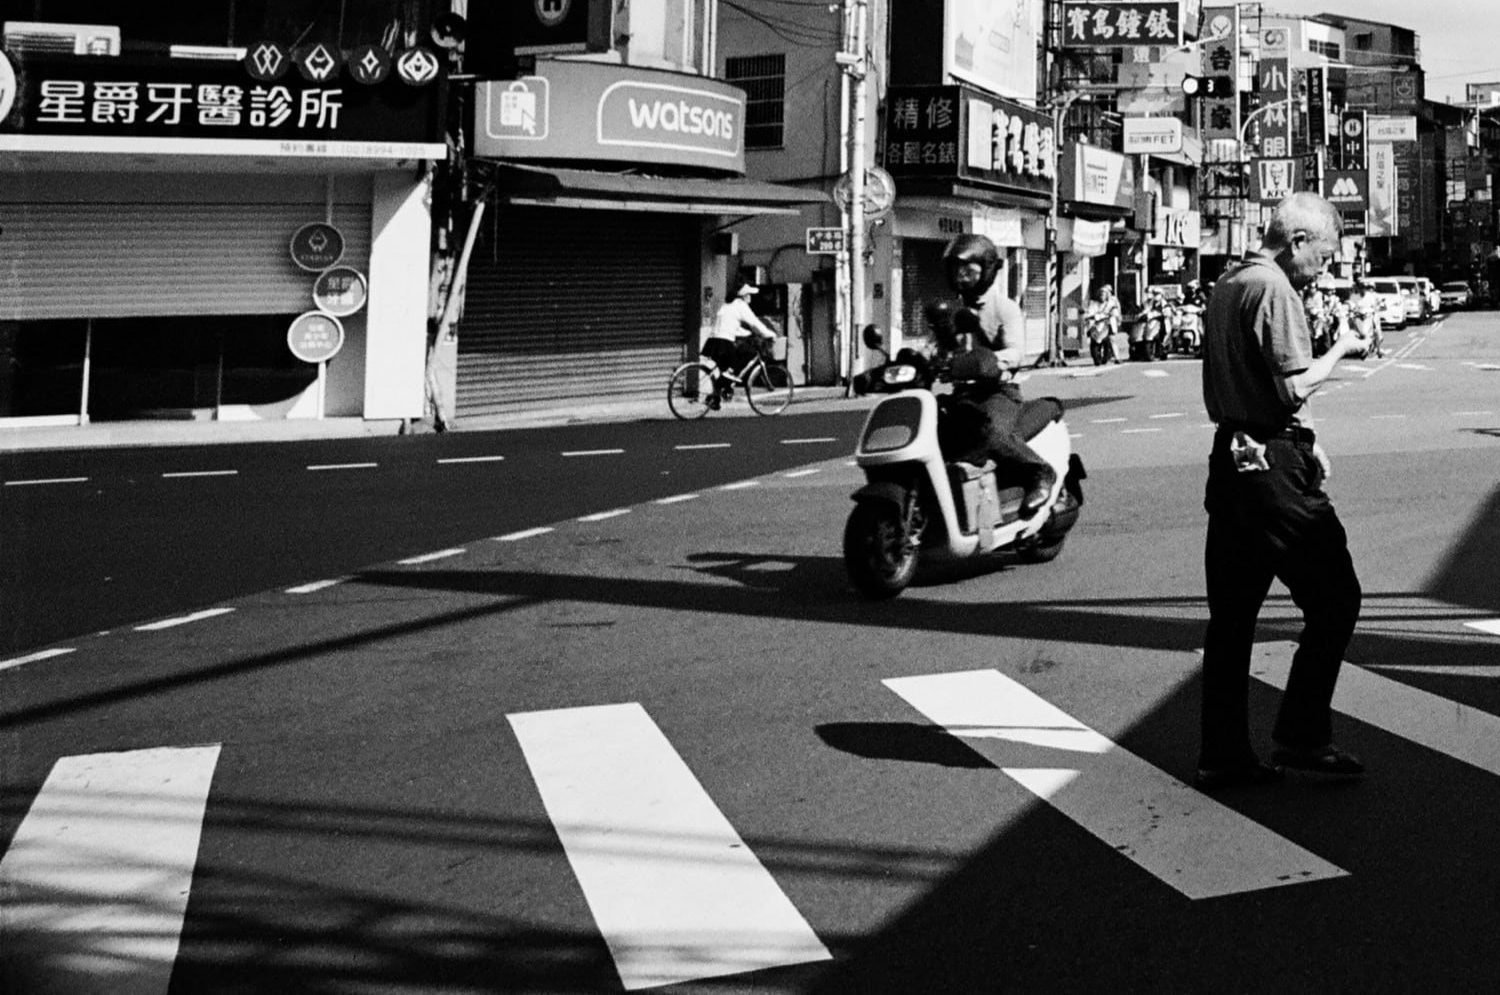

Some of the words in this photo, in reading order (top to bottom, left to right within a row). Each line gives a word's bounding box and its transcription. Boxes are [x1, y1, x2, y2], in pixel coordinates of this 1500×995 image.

[1067, 7, 1175, 41] 寶島鐘錶
[37, 79, 343, 130] 星爵牙醫診所
[629, 97, 733, 141] watsons
[893, 97, 953, 130] 精修
